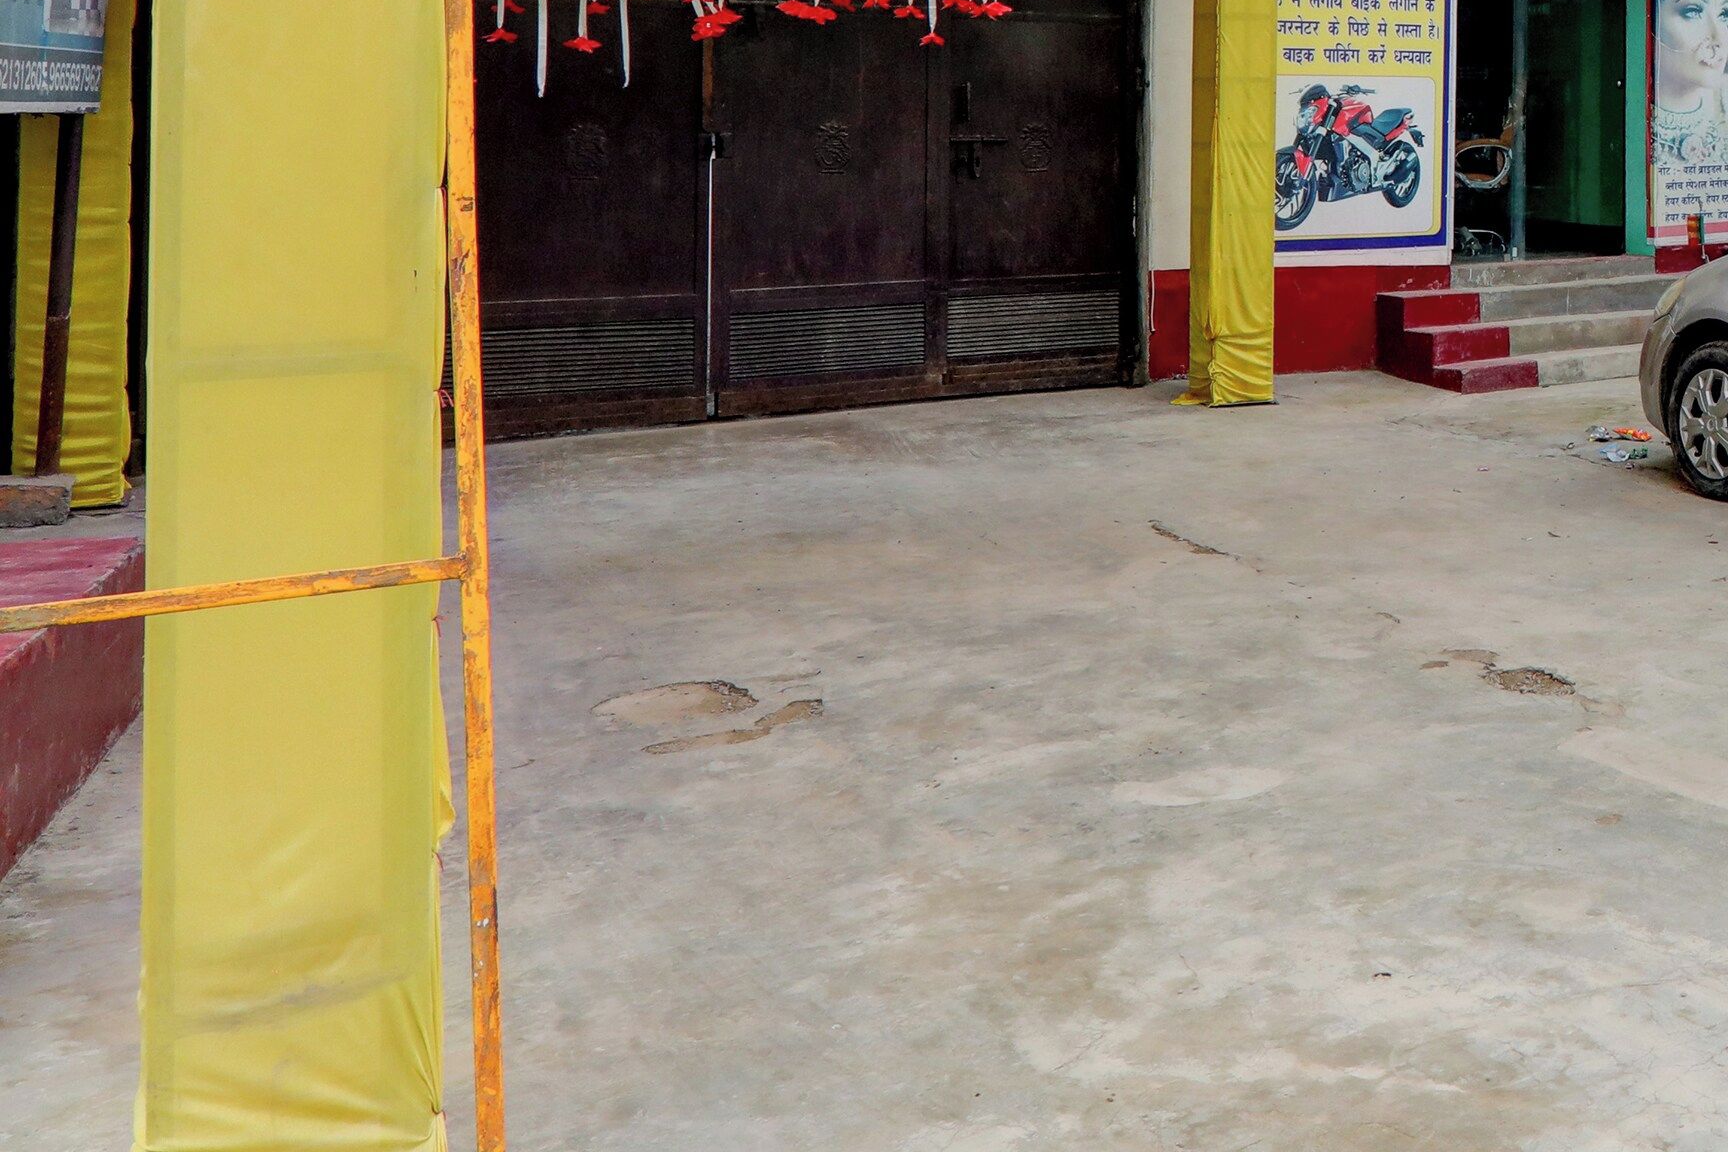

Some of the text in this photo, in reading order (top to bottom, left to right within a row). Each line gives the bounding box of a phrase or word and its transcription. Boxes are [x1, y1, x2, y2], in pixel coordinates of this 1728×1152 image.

[1328, 16, 1340, 36] के
[1348, 16, 1369, 36] पिछे
[1377, 18, 1387, 37] से
[1395, 23, 1421, 38] रास्ता
[1283, 42, 1432, 65] बाइक पार्किंग करें धन्यवाद
